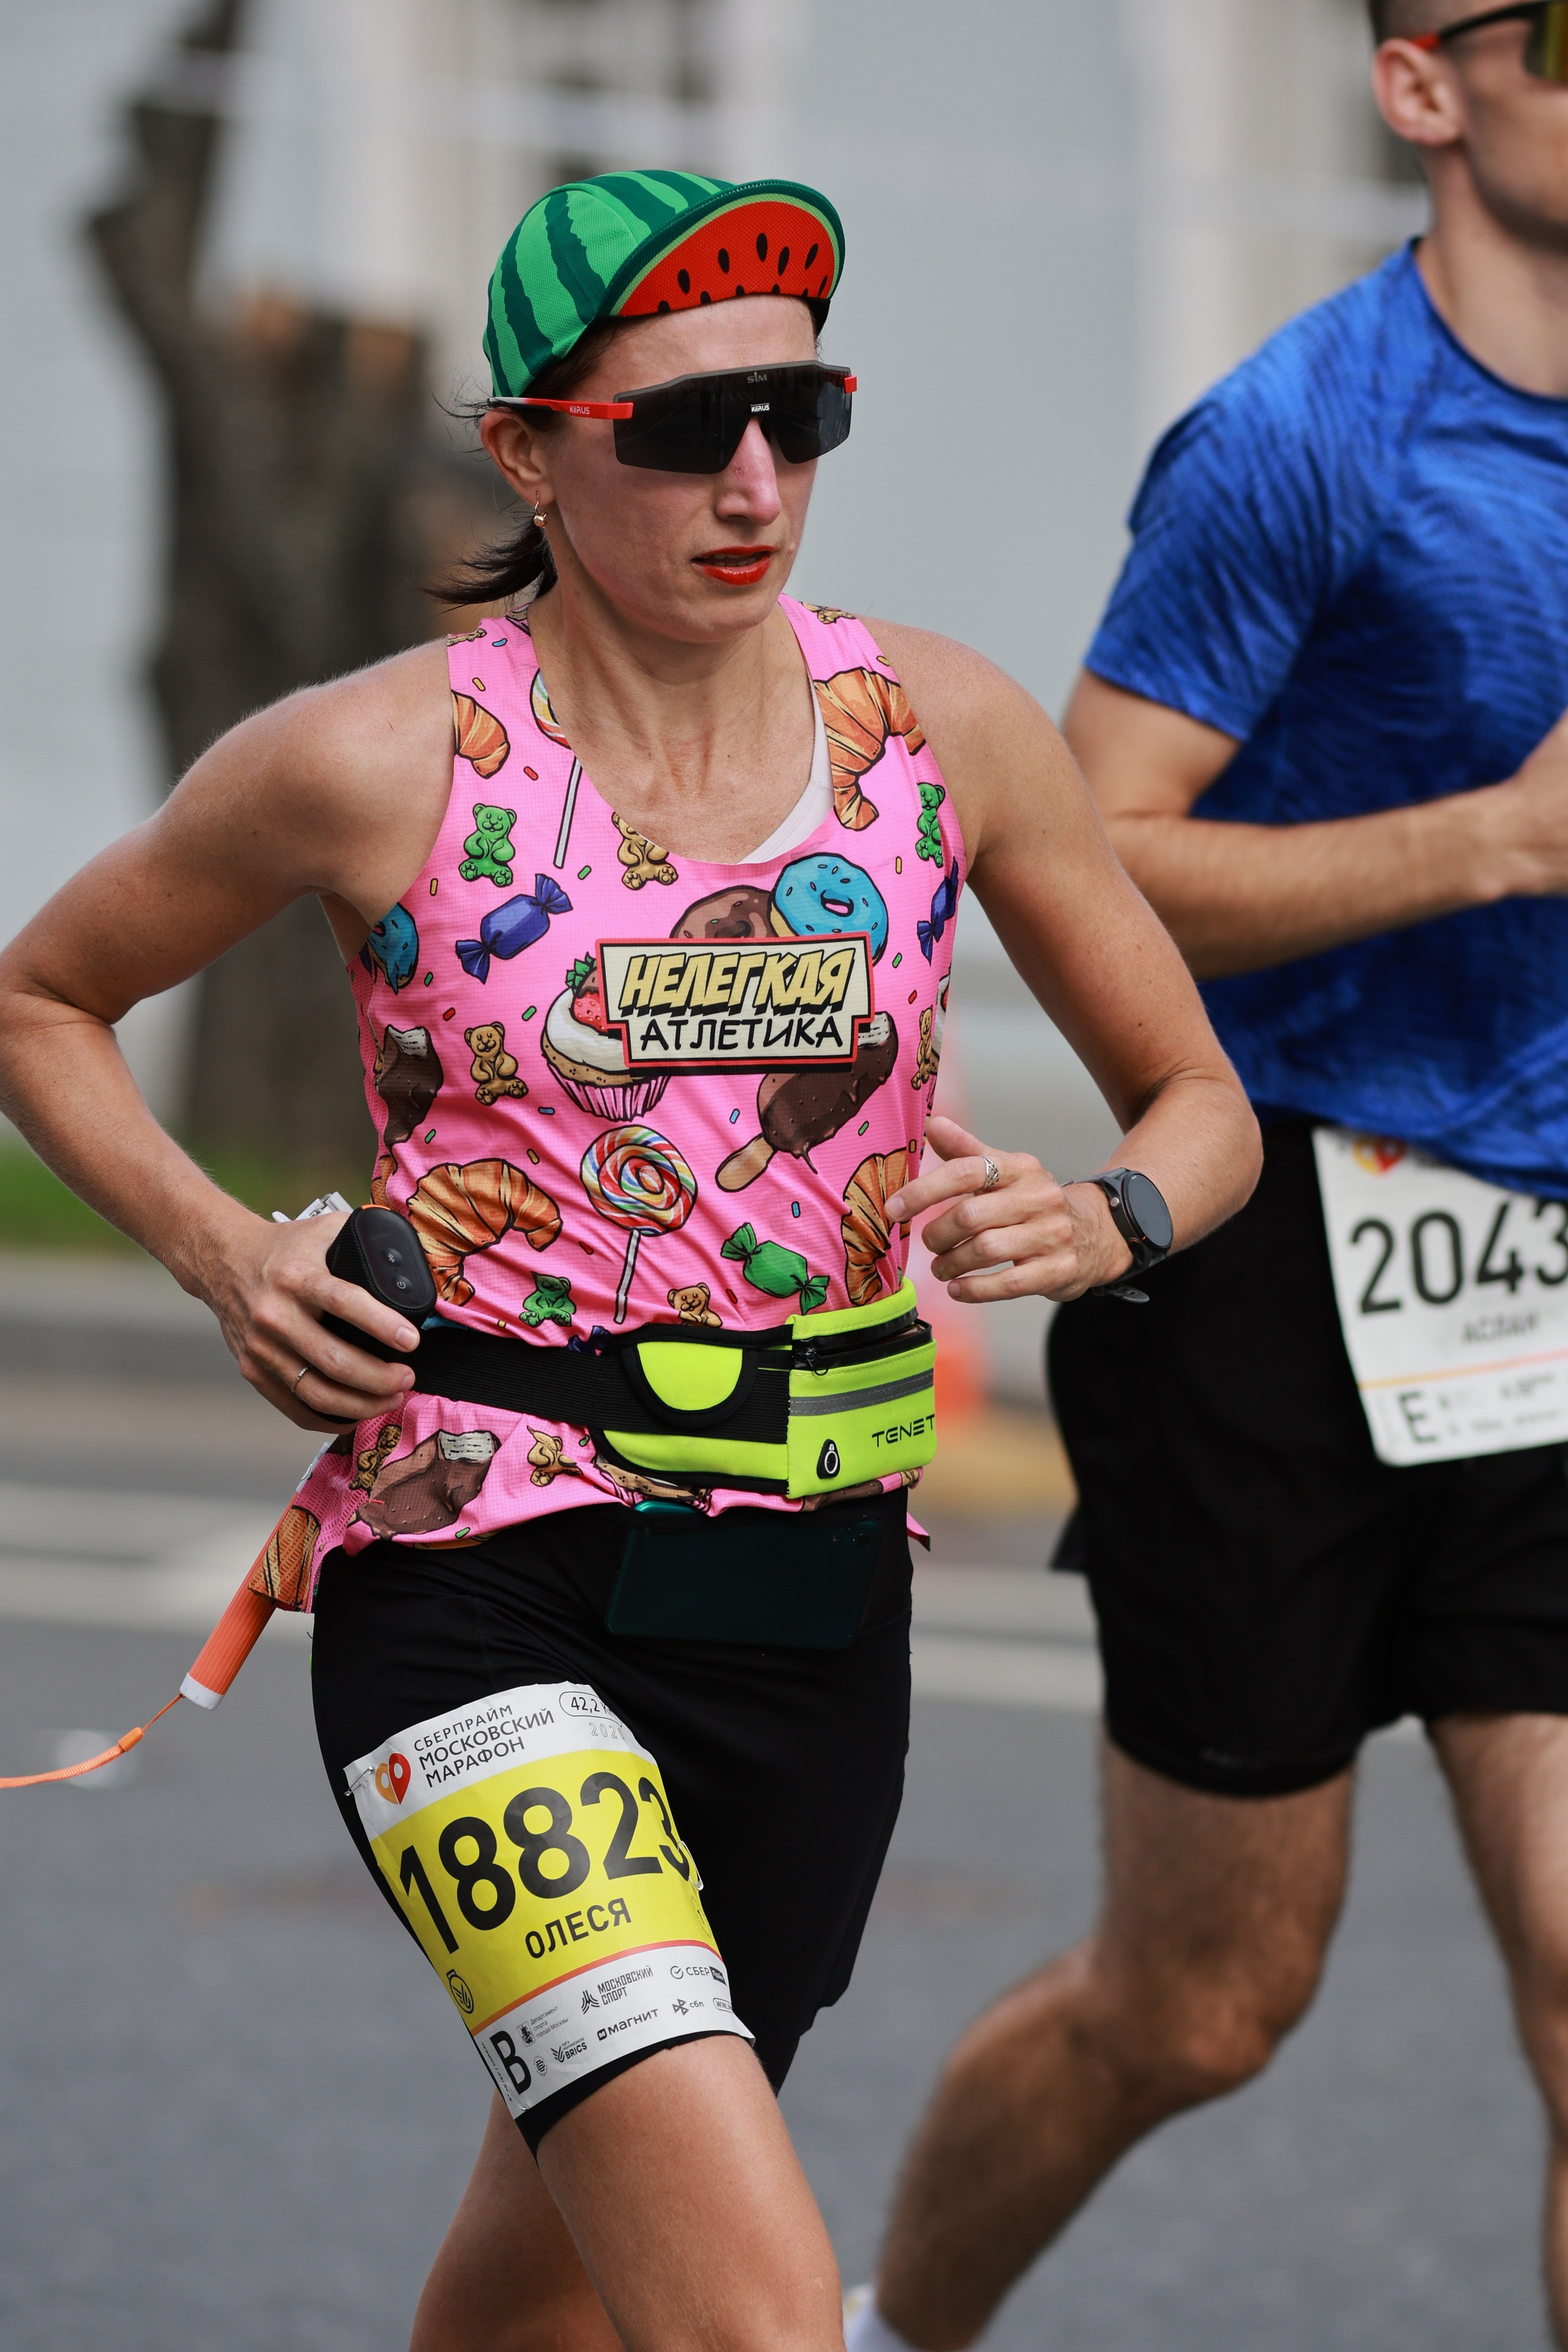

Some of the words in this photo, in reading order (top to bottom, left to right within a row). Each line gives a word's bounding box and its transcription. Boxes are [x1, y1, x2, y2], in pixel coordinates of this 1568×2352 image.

[618, 948, 856, 1017] НЕЛЕГКАЯ
[640, 1016, 843, 1051] АТЛЕТИКА
[872, 1414, 935, 1447] TENET
[571, 1697, 600, 1713] 42,2
[413, 1705, 513, 1752] СБЕРПРАЙМ
[419, 1708, 554, 1771] МОСКОВСКИЙ
[426, 1736, 525, 1788] МАРАФОН
[399, 1771, 690, 1954] 18823
[525, 1897, 631, 1959] ОЛЕСЯ
[597, 1965, 654, 1994] МОСКОВСКИЙ
[686, 1967, 710, 1976] СБЕР
[601, 1986, 627, 2005] СПОРТ
[530, 2006, 559, 2026] Департамент
[533, 2021, 548, 2032] спорта
[537, 2027, 551, 2038] города
[550, 2018, 568, 2030] Москвы
[489, 2030, 532, 2095] B
[565, 2042, 587, 2059] BRICS
